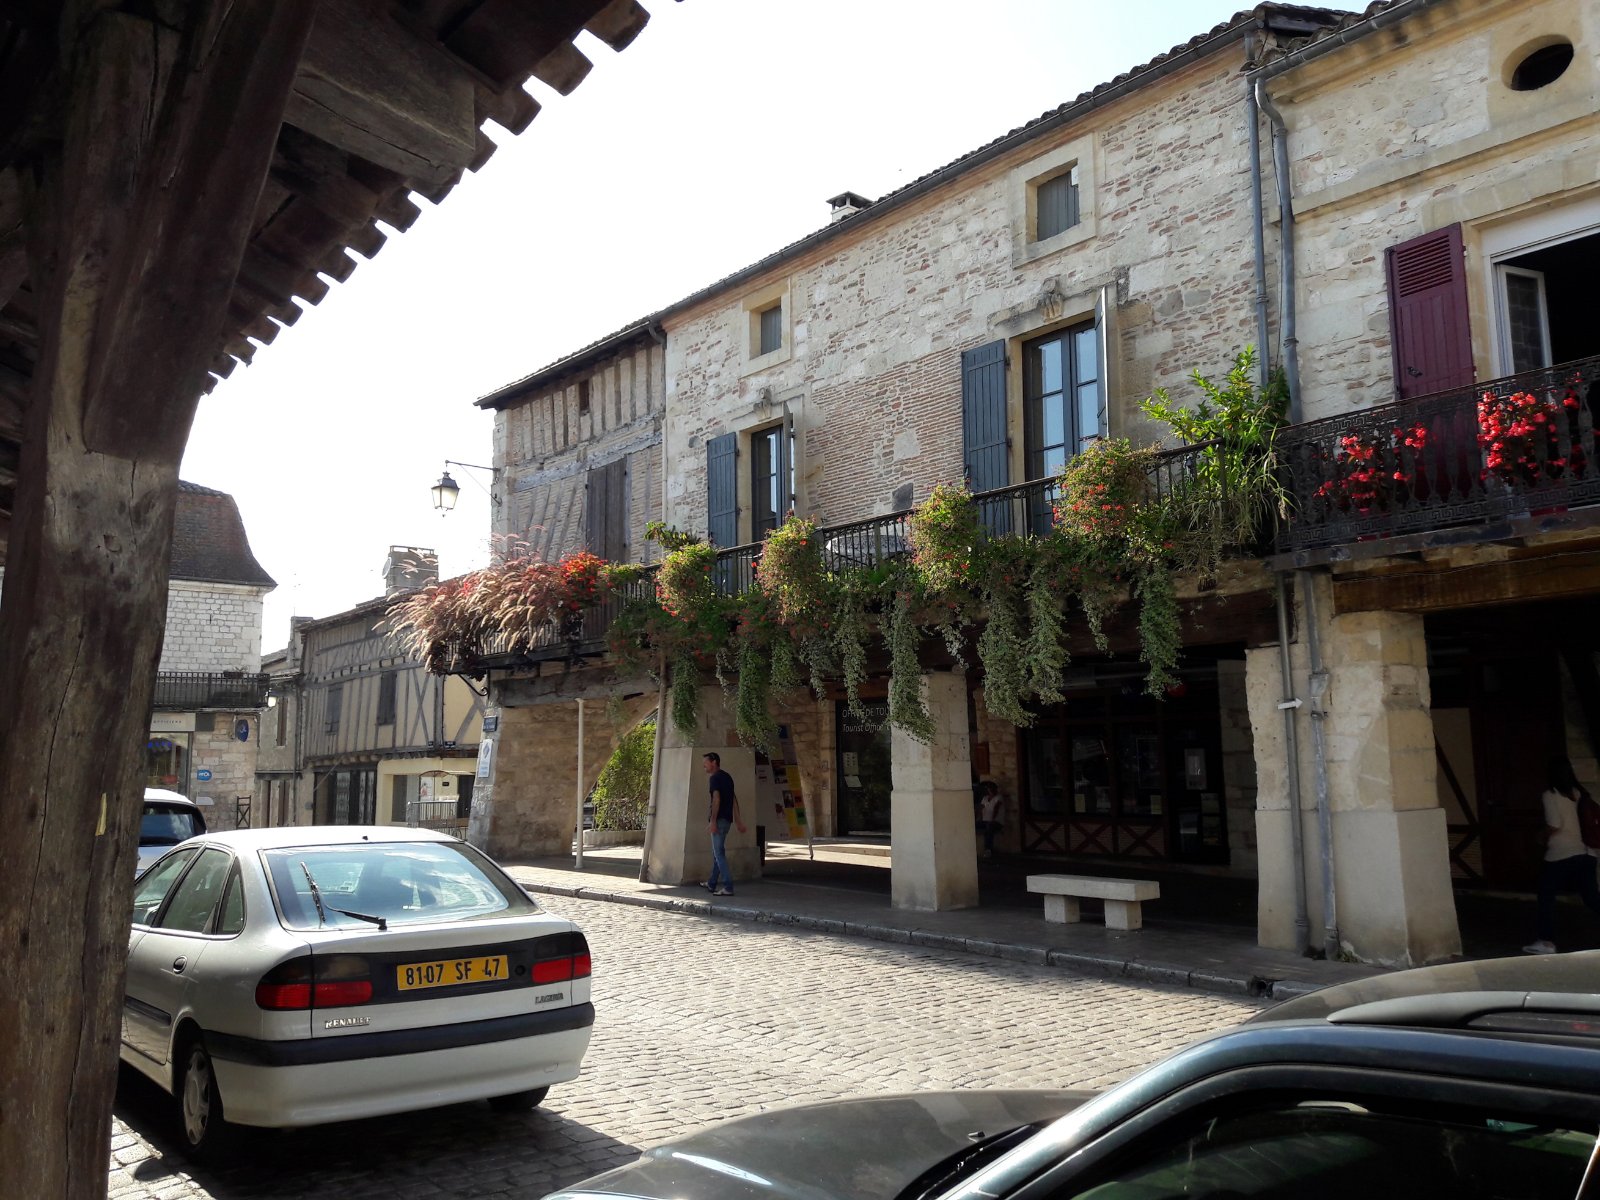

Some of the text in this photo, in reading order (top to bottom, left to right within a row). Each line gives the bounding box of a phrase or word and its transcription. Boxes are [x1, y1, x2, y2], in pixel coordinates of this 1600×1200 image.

[866, 708, 874, 717] DE
[843, 723, 863, 733] Tourist
[405, 958, 500, 986] 8107 SF 47
[325, 1016, 371, 1029] RENAULT
